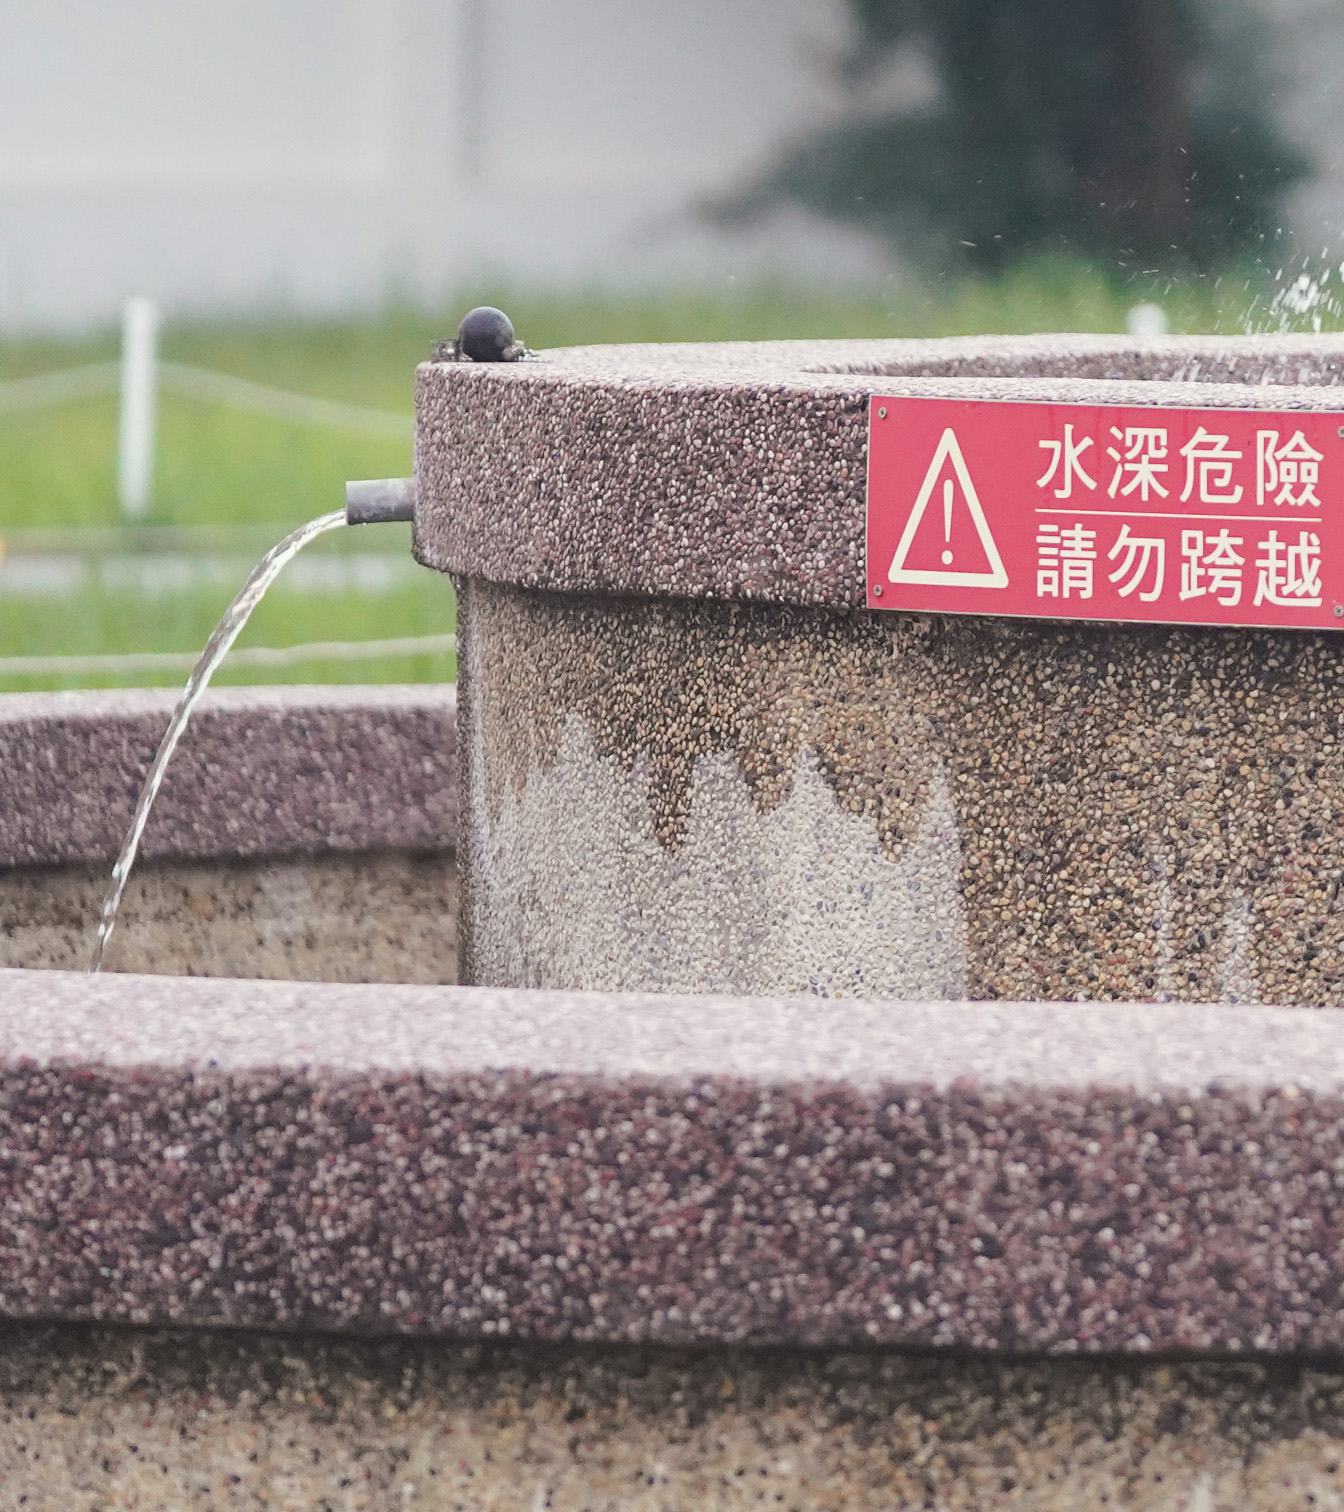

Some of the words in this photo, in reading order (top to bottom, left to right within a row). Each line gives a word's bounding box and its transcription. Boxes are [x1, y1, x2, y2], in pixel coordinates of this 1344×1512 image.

[1035, 423, 1324, 508] 水深危險
[1035, 522, 1323, 607] 請勿跨越
